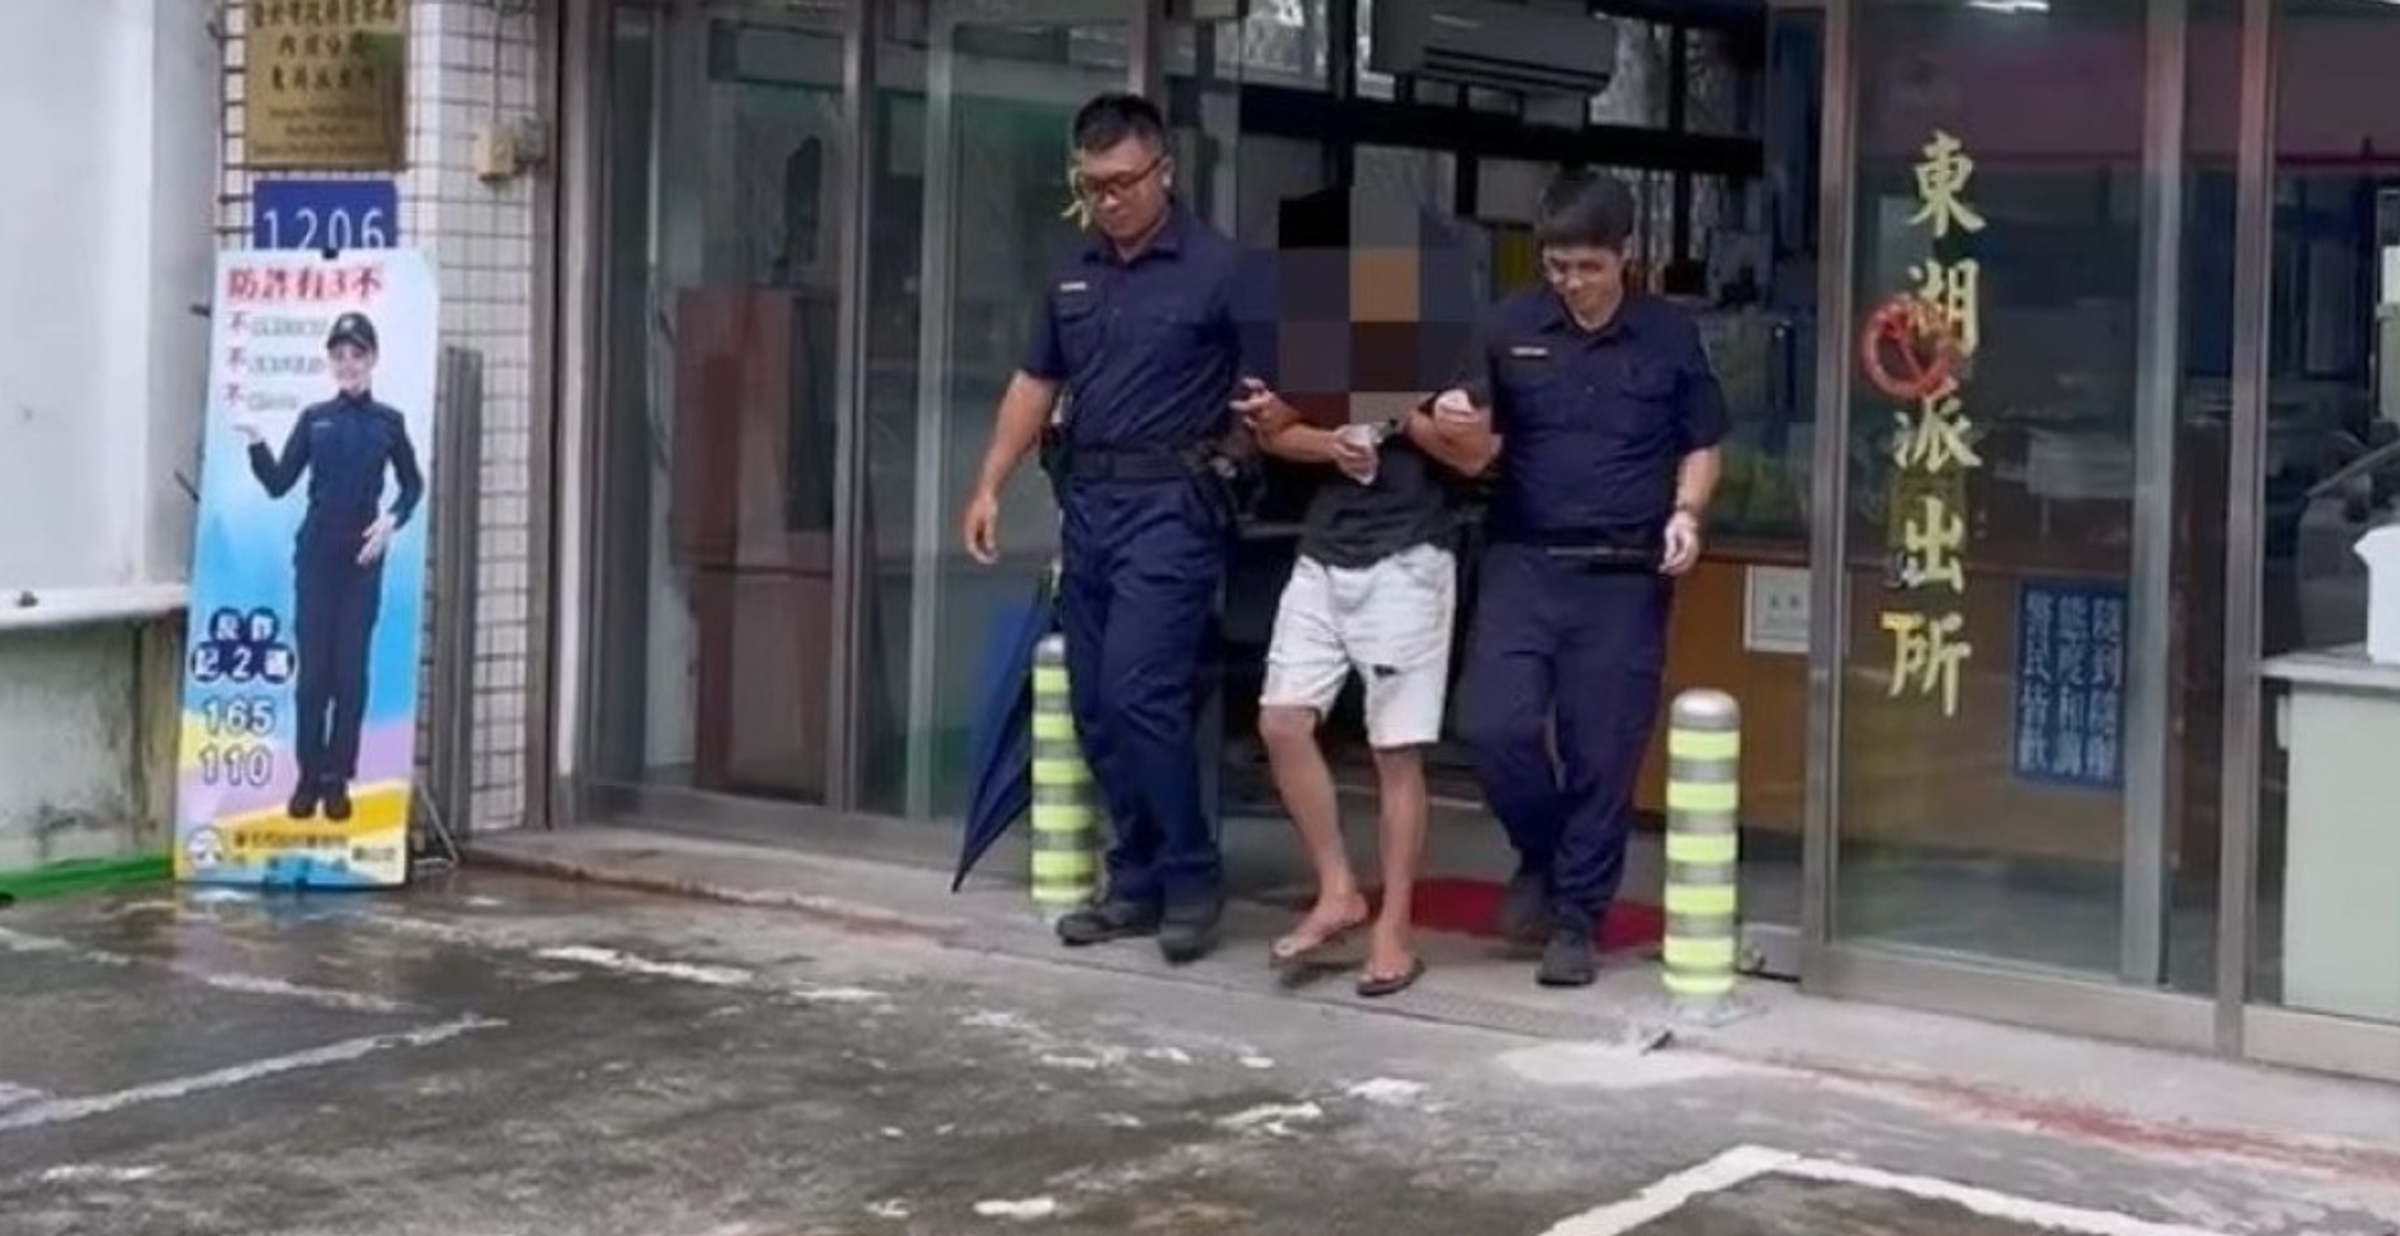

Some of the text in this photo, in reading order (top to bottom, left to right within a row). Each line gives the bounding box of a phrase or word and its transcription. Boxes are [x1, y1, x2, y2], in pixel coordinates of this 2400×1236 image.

[262, 208, 386, 248] 1206
[1880, 130, 1987, 717] 東湖派出所
[203, 696, 276, 735] 165
[198, 742, 273, 786] 110
